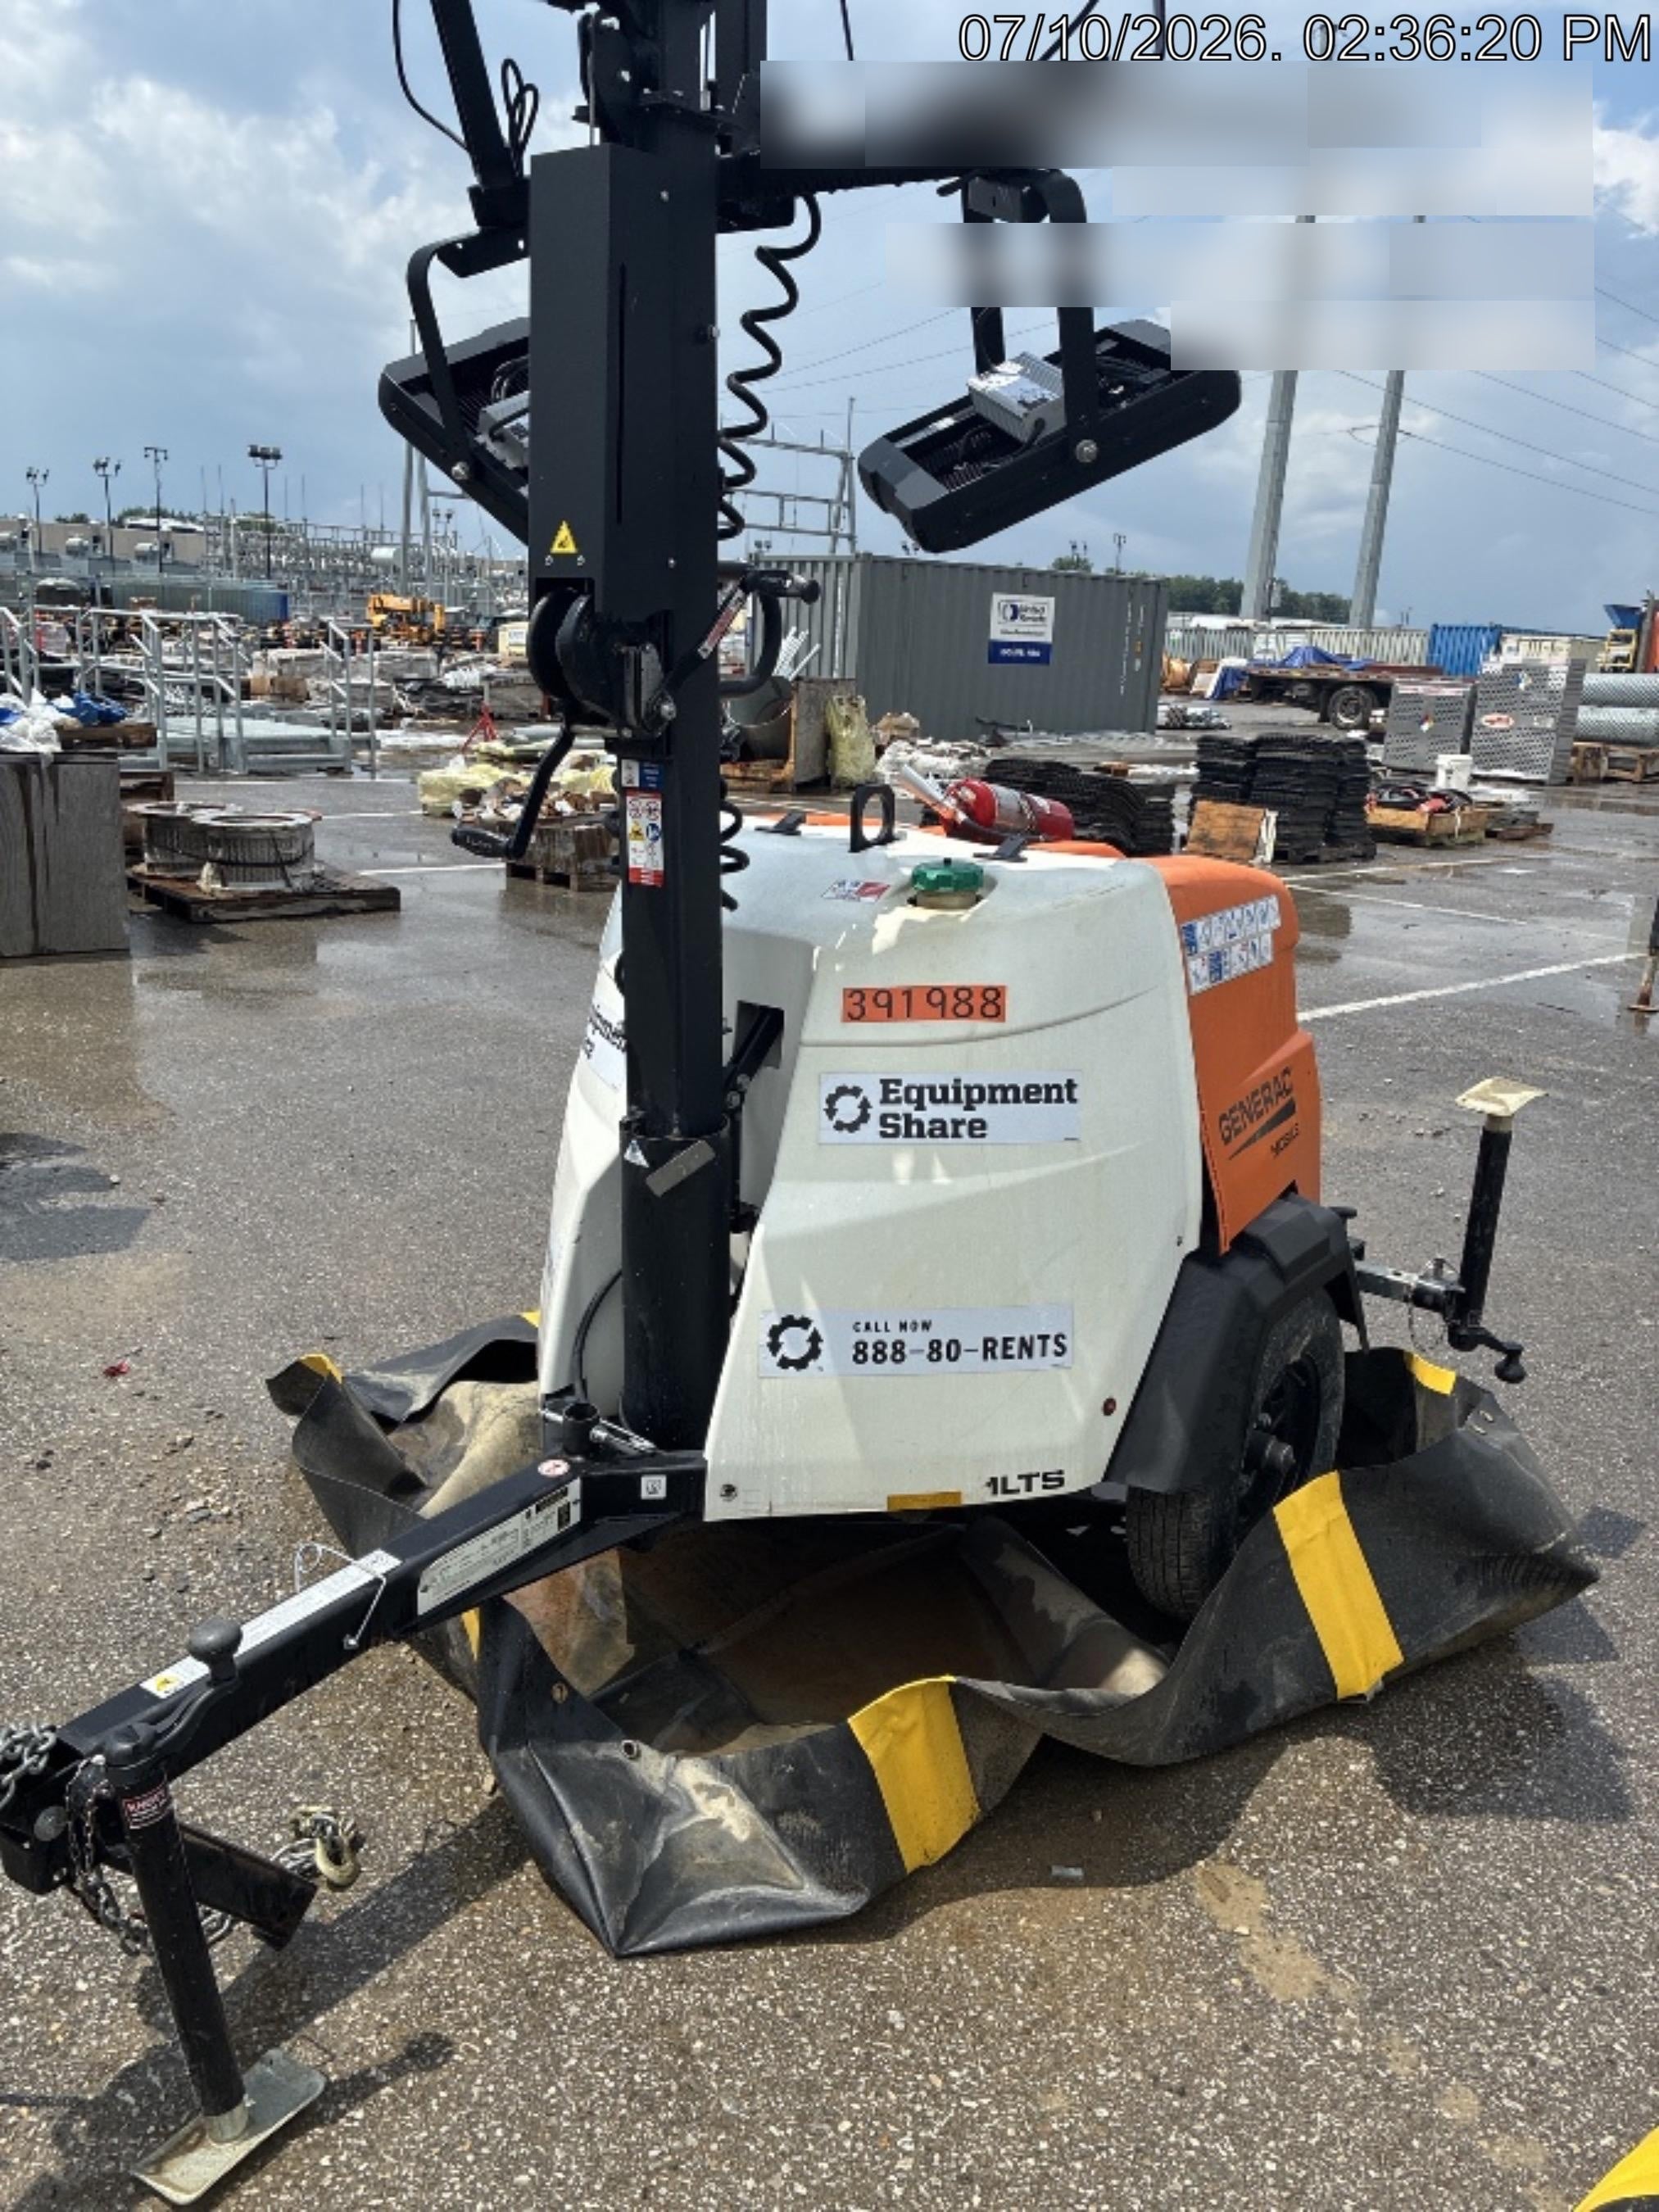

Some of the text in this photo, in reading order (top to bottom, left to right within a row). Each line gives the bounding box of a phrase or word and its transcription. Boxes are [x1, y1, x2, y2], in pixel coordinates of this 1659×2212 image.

[847, 987, 1002, 1021] 391988
[879, 1077, 1078, 1111] Equipment
[1218, 1066, 1294, 1146] GENERAC
[879, 1113, 988, 1140] Share
[852, 1319, 933, 1333] CALL NOW
[852, 1332, 1068, 1366] 888-80-RENTS
